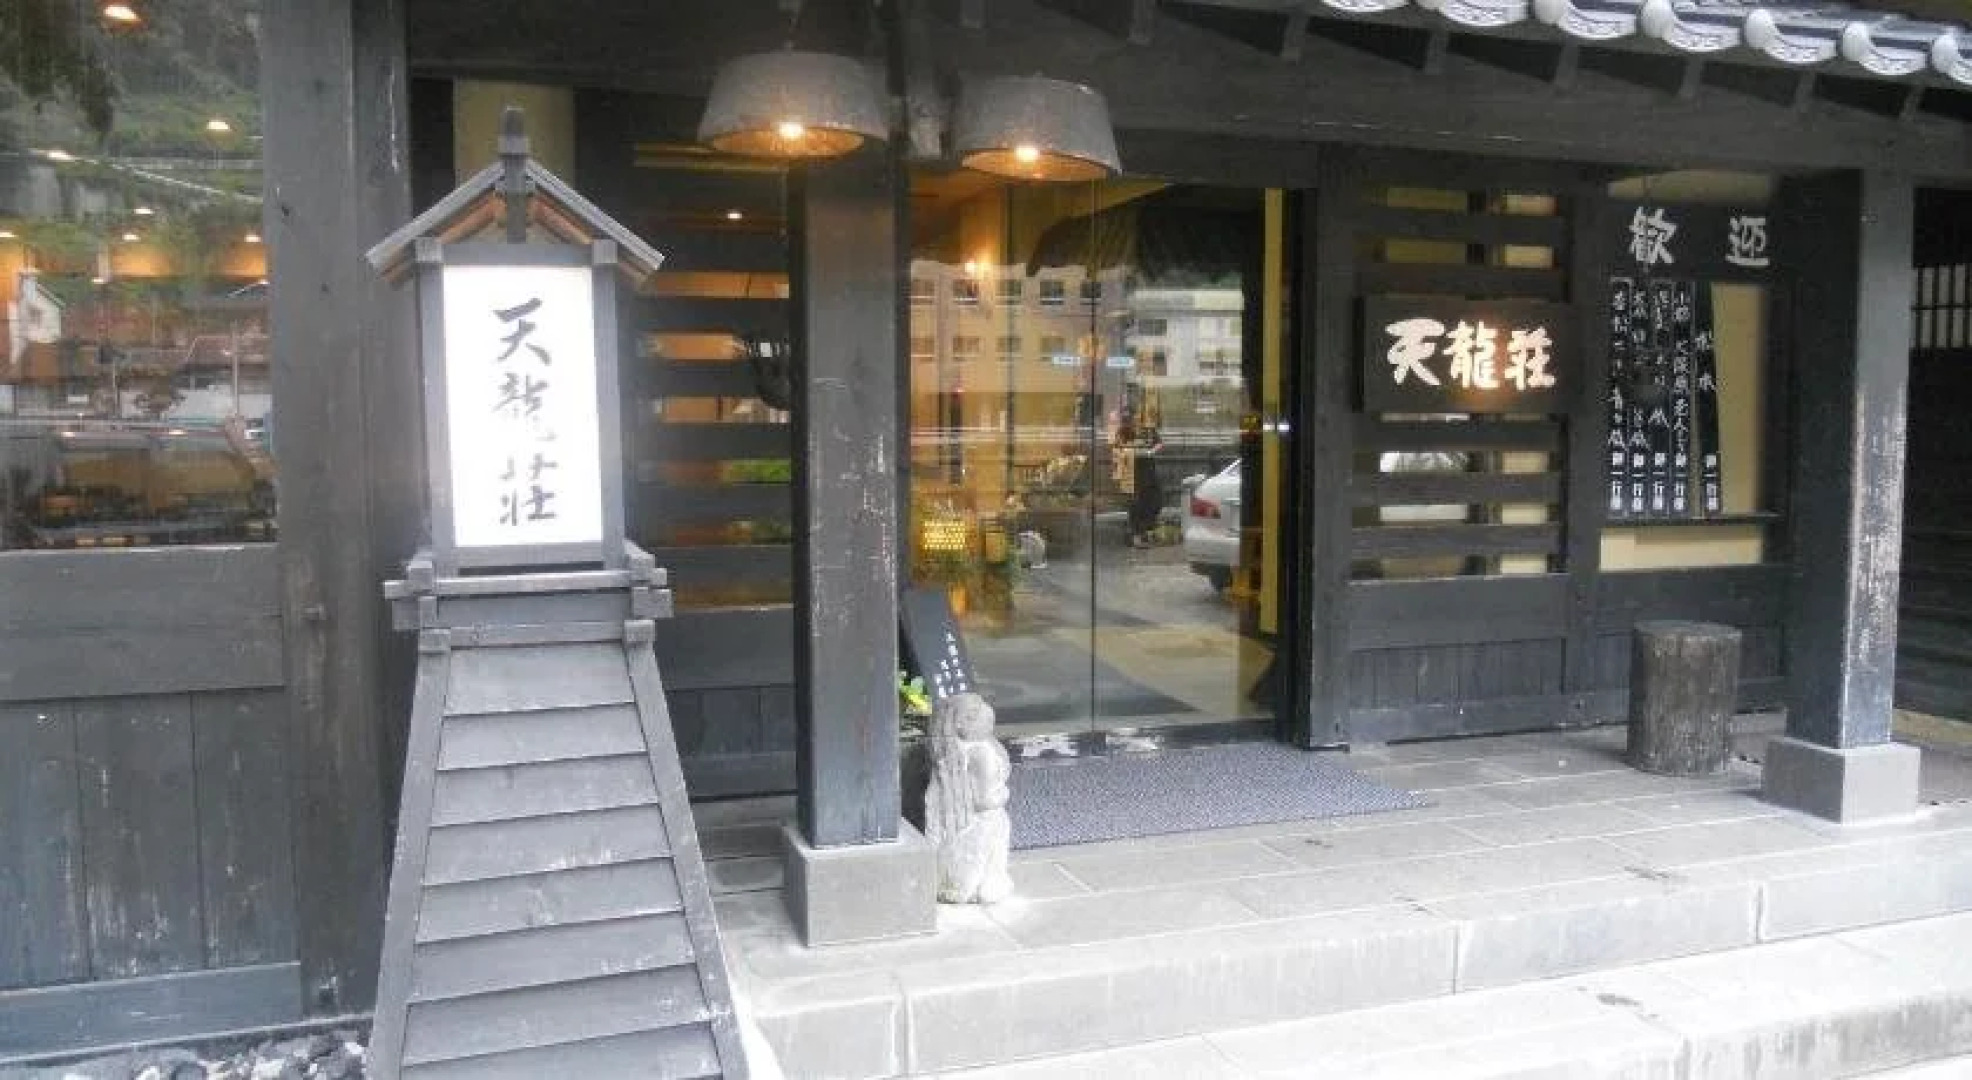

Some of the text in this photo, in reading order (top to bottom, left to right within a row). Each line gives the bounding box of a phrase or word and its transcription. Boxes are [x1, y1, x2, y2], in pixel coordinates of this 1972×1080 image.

[492, 297, 558, 526] 天龍荘
[1385, 317, 1556, 391] 天龍荘
